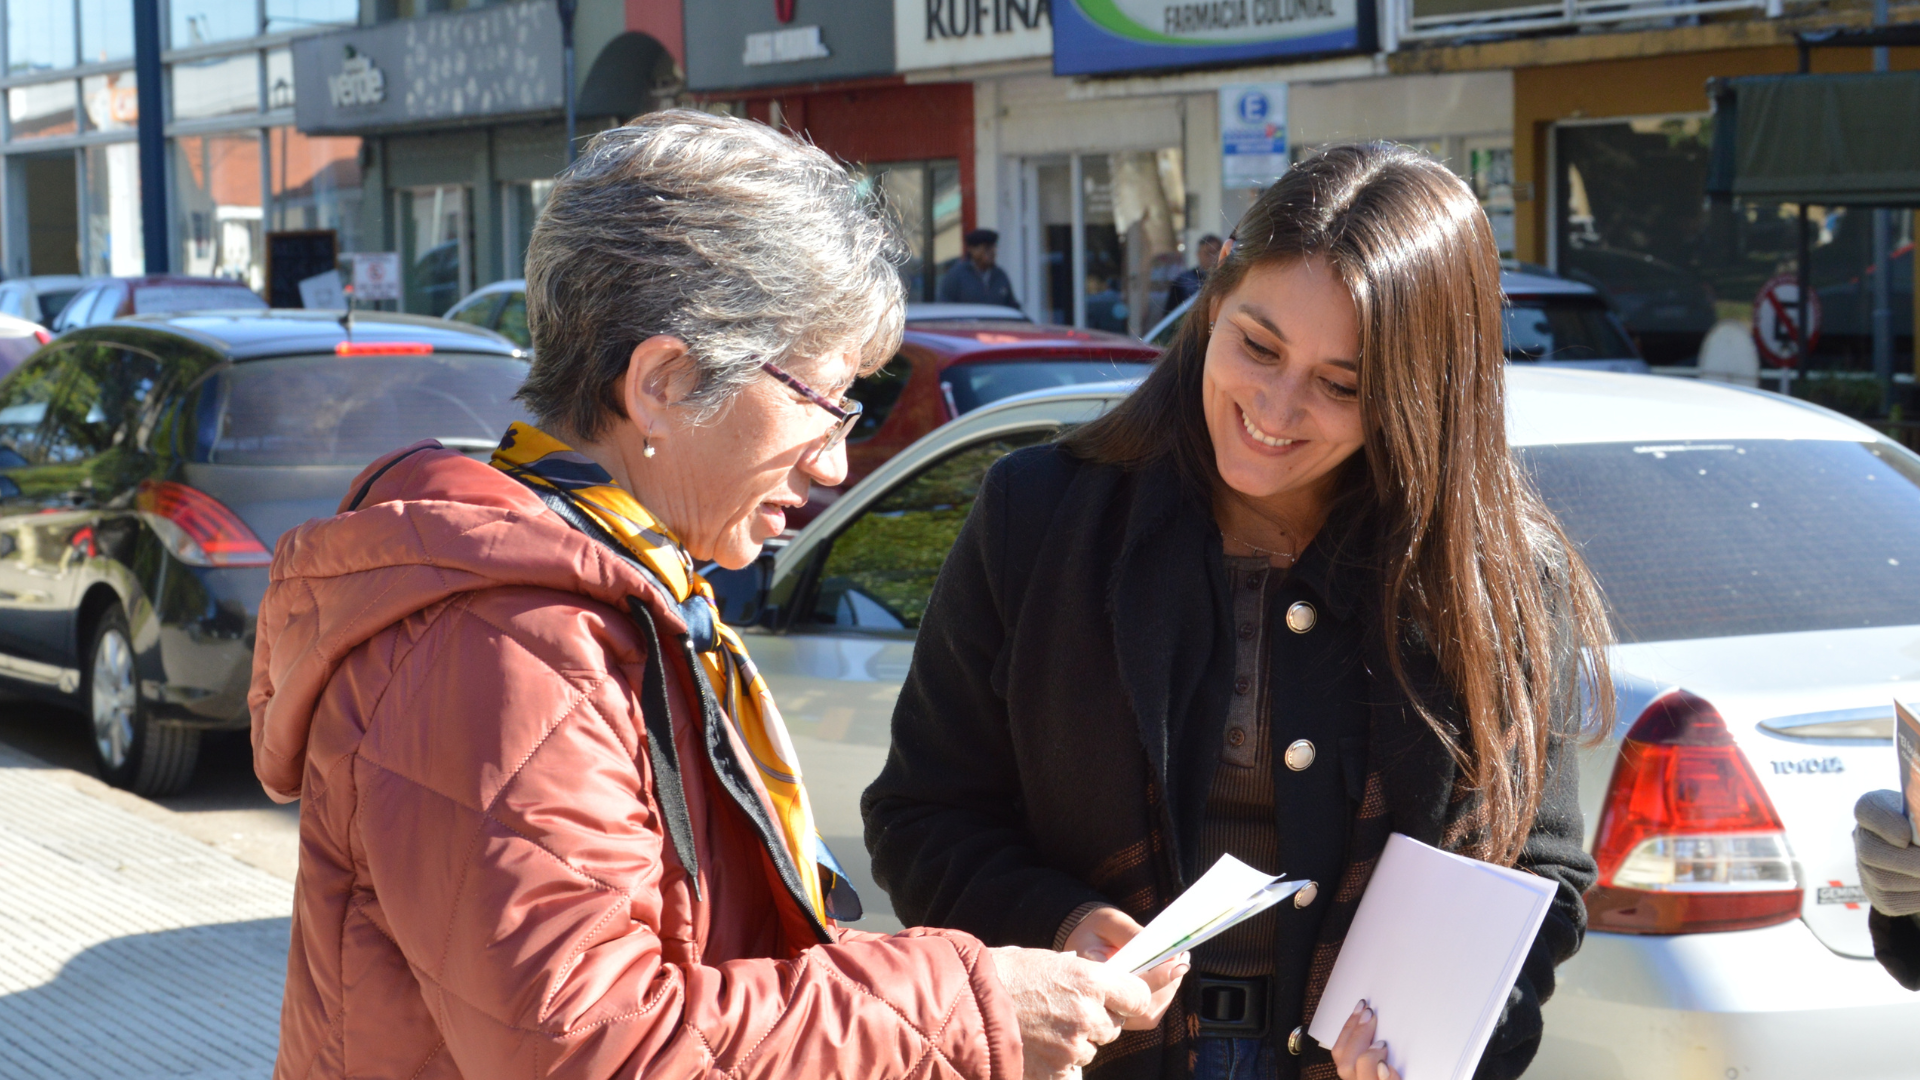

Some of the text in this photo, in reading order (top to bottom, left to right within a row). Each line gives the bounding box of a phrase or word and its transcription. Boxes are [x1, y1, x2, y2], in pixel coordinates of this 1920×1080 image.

[1164, 0, 1336, 34] FARMACIA COLONIAL
[1244, 95, 1262, 120] E
[1770, 756, 1846, 775] TOYOTA
